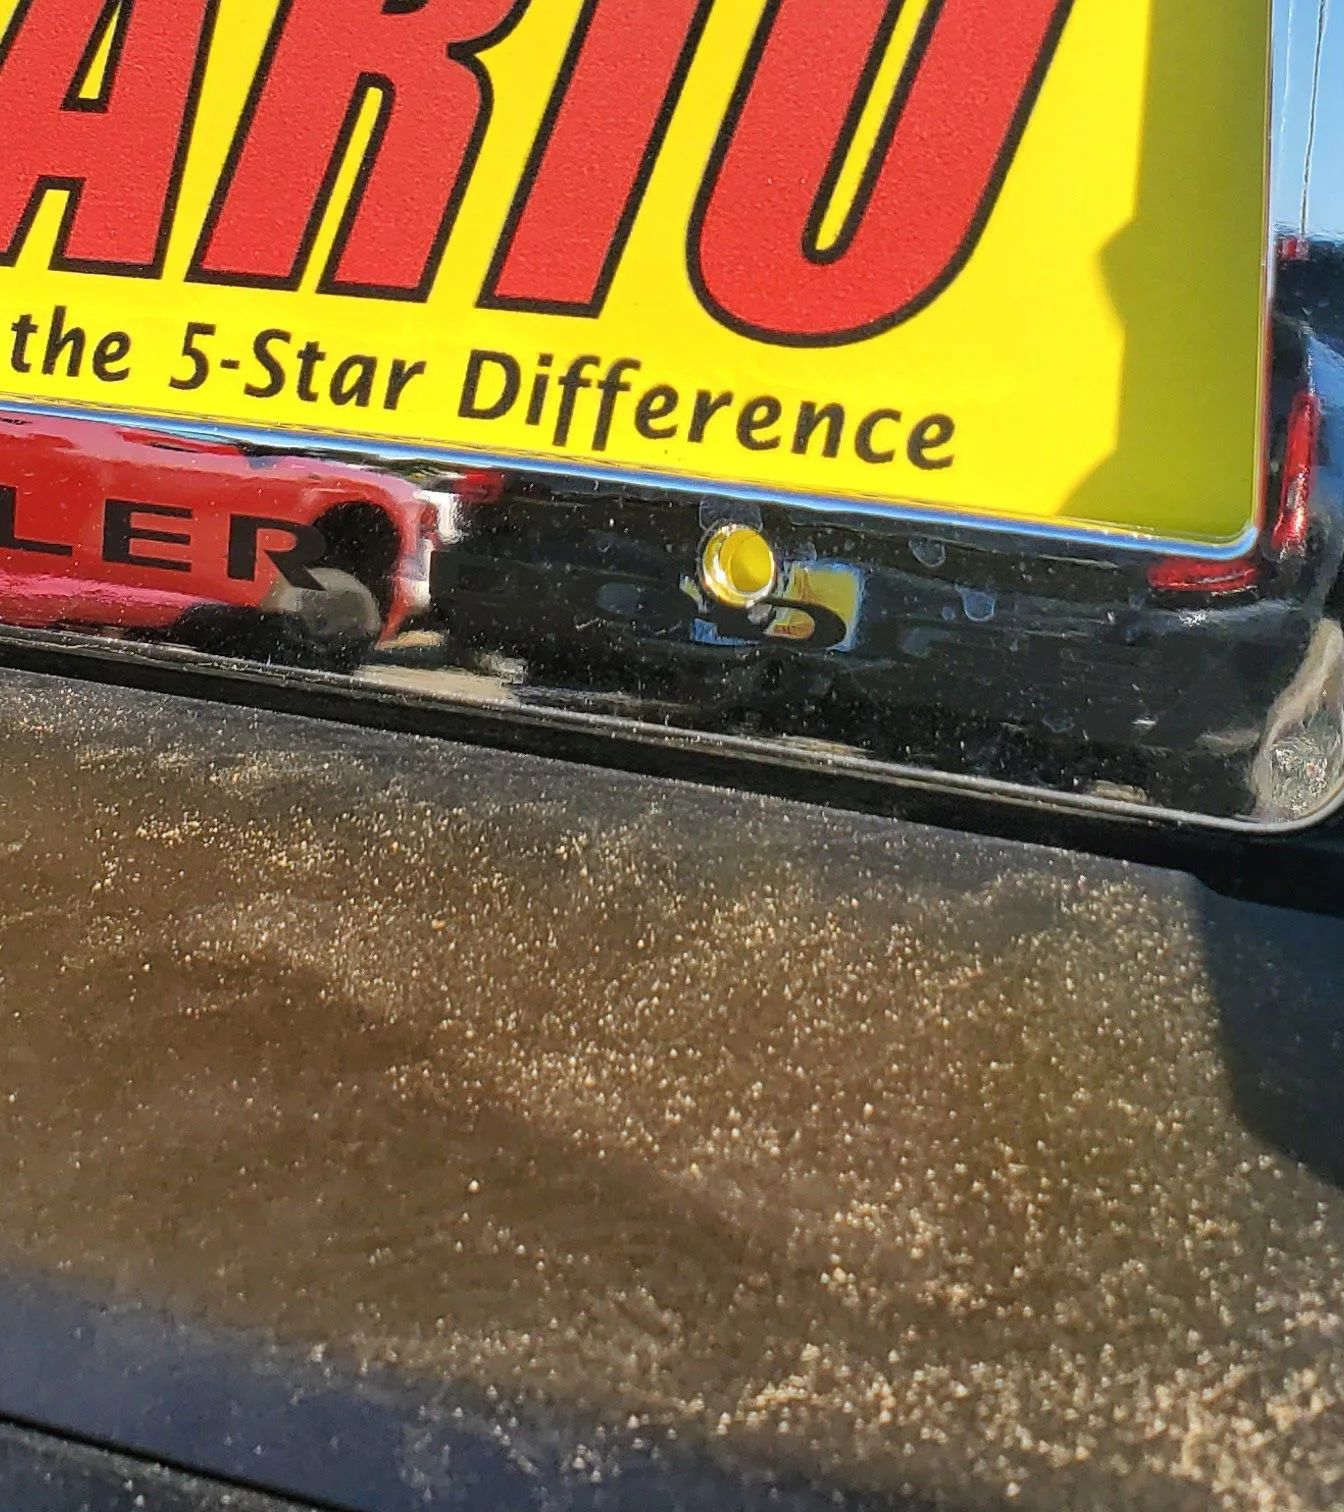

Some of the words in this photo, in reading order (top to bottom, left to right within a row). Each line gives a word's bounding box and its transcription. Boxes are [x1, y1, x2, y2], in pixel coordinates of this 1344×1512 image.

[10, 303, 133, 384] the
[167, 320, 429, 412] 5-Star
[456, 346, 957, 473] Difference
